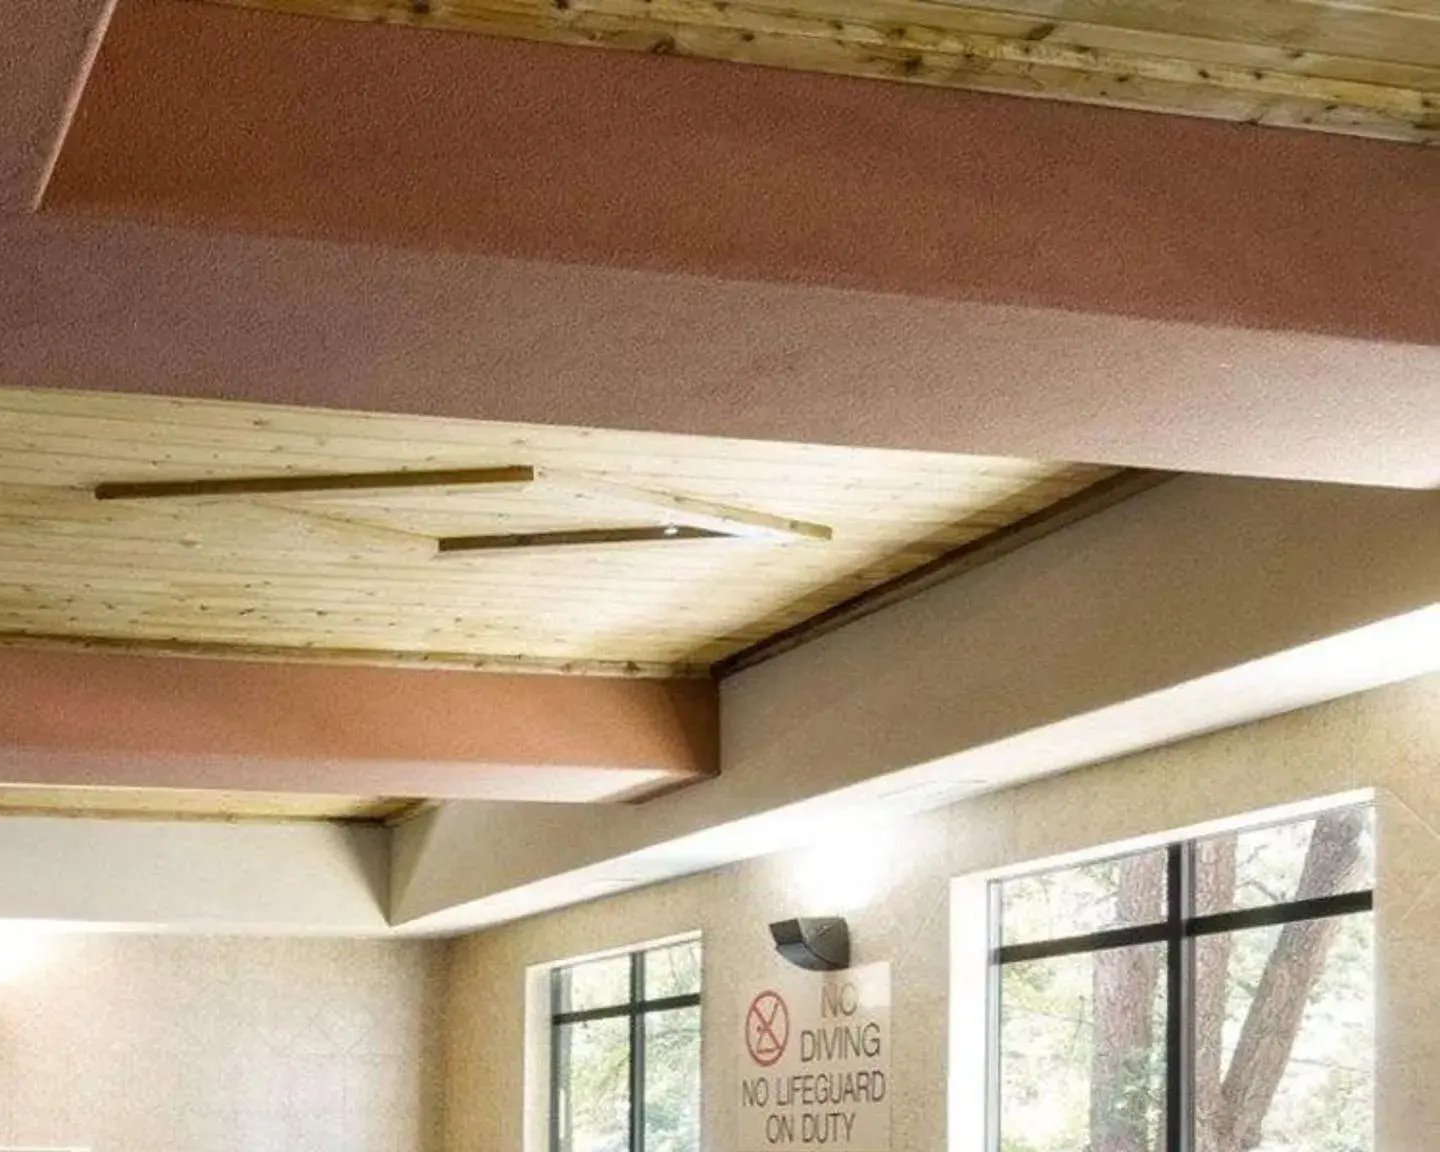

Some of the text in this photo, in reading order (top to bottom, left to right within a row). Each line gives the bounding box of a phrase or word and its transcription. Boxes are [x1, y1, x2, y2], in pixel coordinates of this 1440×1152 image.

[821, 983, 859, 1018] NO
[800, 1022, 881, 1062] DIVING
[742, 1070, 886, 1107] NO LIFEGUARD
[766, 1112, 857, 1144] ON DUTY
